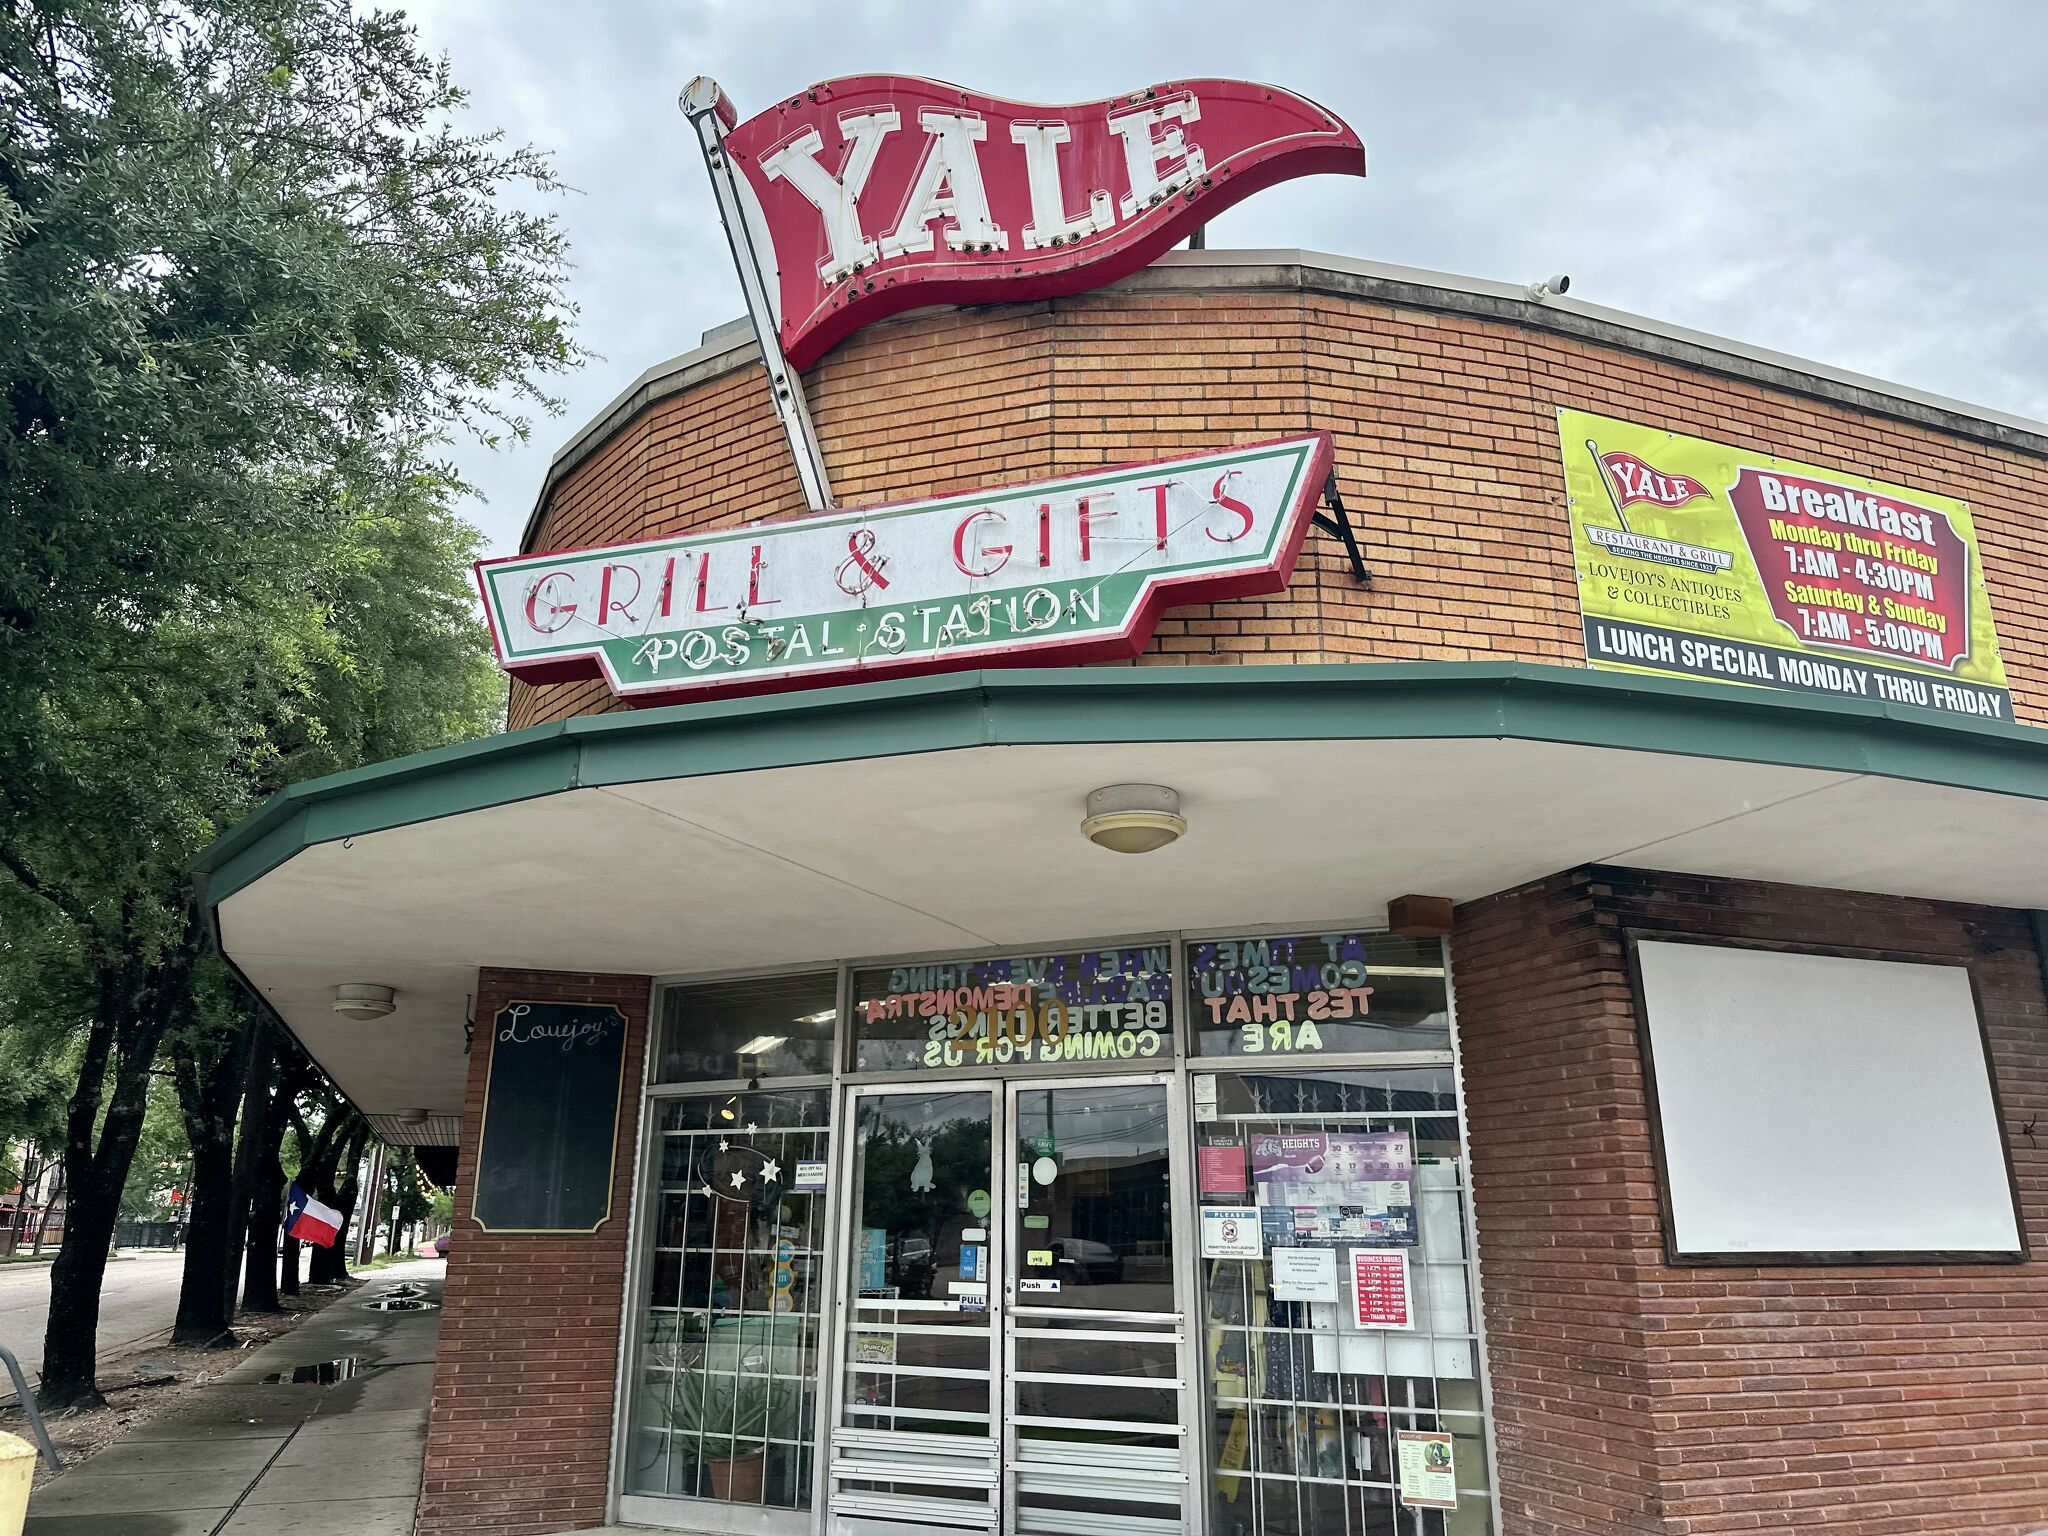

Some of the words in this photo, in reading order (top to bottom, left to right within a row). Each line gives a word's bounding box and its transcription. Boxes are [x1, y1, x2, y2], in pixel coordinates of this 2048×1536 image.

[757, 89, 1206, 288] YALE
[1610, 461, 1690, 501] YALE
[1757, 474, 1936, 546] Breakfast
[522, 545, 781, 633] GRILL
[834, 528, 890, 596] &
[953, 470, 1255, 577] GIFTS
[1596, 530, 1674, 555] RESTAURANT
[1679, 546, 1687, 557] &
[1690, 549, 1725, 565] GRILL
[1612, 546, 1640, 557] SERVING
[1640, 551, 1653, 560] THE
[1653, 554, 1680, 565] HEIGHTS
[1680, 558, 1698, 569] SINCE
[1768, 518, 1842, 552] Monday
[1844, 531, 1882, 559] thru
[1884, 540, 1938, 575] Friday
[1783, 545, 1840, 579] 7:AM
[1855, 558, 1935, 601] 4:30PM
[1589, 562, 1667, 589] LOVEJOY'S
[1670, 578, 1742, 603] ANTIQUES
[1607, 585, 1619, 600] &
[1624, 589, 1732, 620] COLLECTIBLES
[1783, 580, 1865, 614] Saturday
[1868, 595, 1882, 617] &
[1884, 596, 1946, 634] Sunday
[632, 620, 845, 674] POSTAL
[873, 586, 1100, 650] STATION
[1797, 608, 1851, 641] 7:AM
[1865, 618, 1945, 661] 5:00PM
[1597, 625, 1675, 663] LUNCH
[1680, 639, 1774, 680] SPECIAL
[1777, 655, 1868, 696] MONDAY
[1873, 673, 1928, 707] THRU
[1935, 683, 2002, 718] FRIDAY
[948, 998, 1069, 1051] 2100
[1282, 1138, 1320, 1149] HEIGHTS
[961, 1296, 984, 1305] PULL
[1021, 1281, 1040, 1289] Push
